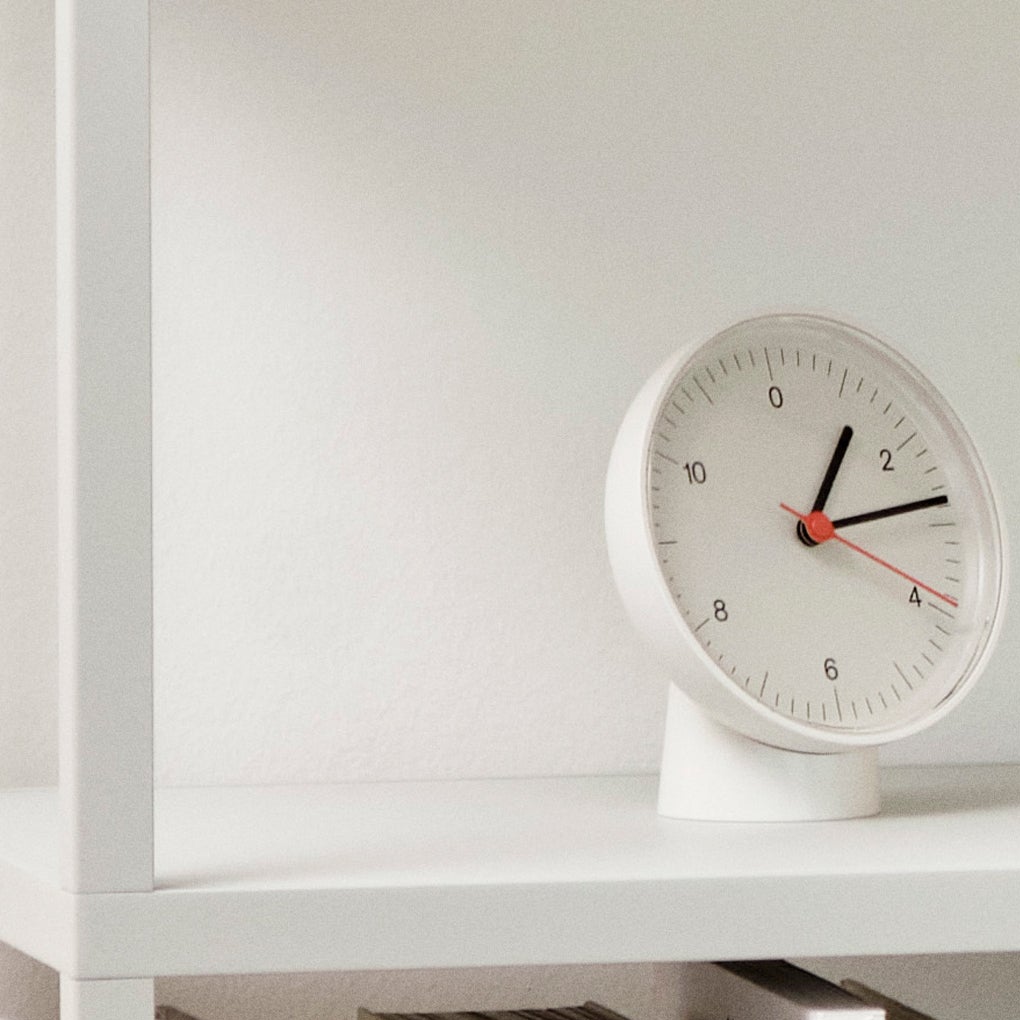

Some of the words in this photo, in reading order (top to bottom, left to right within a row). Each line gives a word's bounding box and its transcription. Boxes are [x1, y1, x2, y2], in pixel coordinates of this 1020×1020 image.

[769, 386, 783, 408] 0
[880, 449, 894, 471] 2
[683, 461, 706, 484] 10
[909, 584, 923, 607] 4
[713, 599, 728, 622] 8
[824, 658, 838, 681] 6
